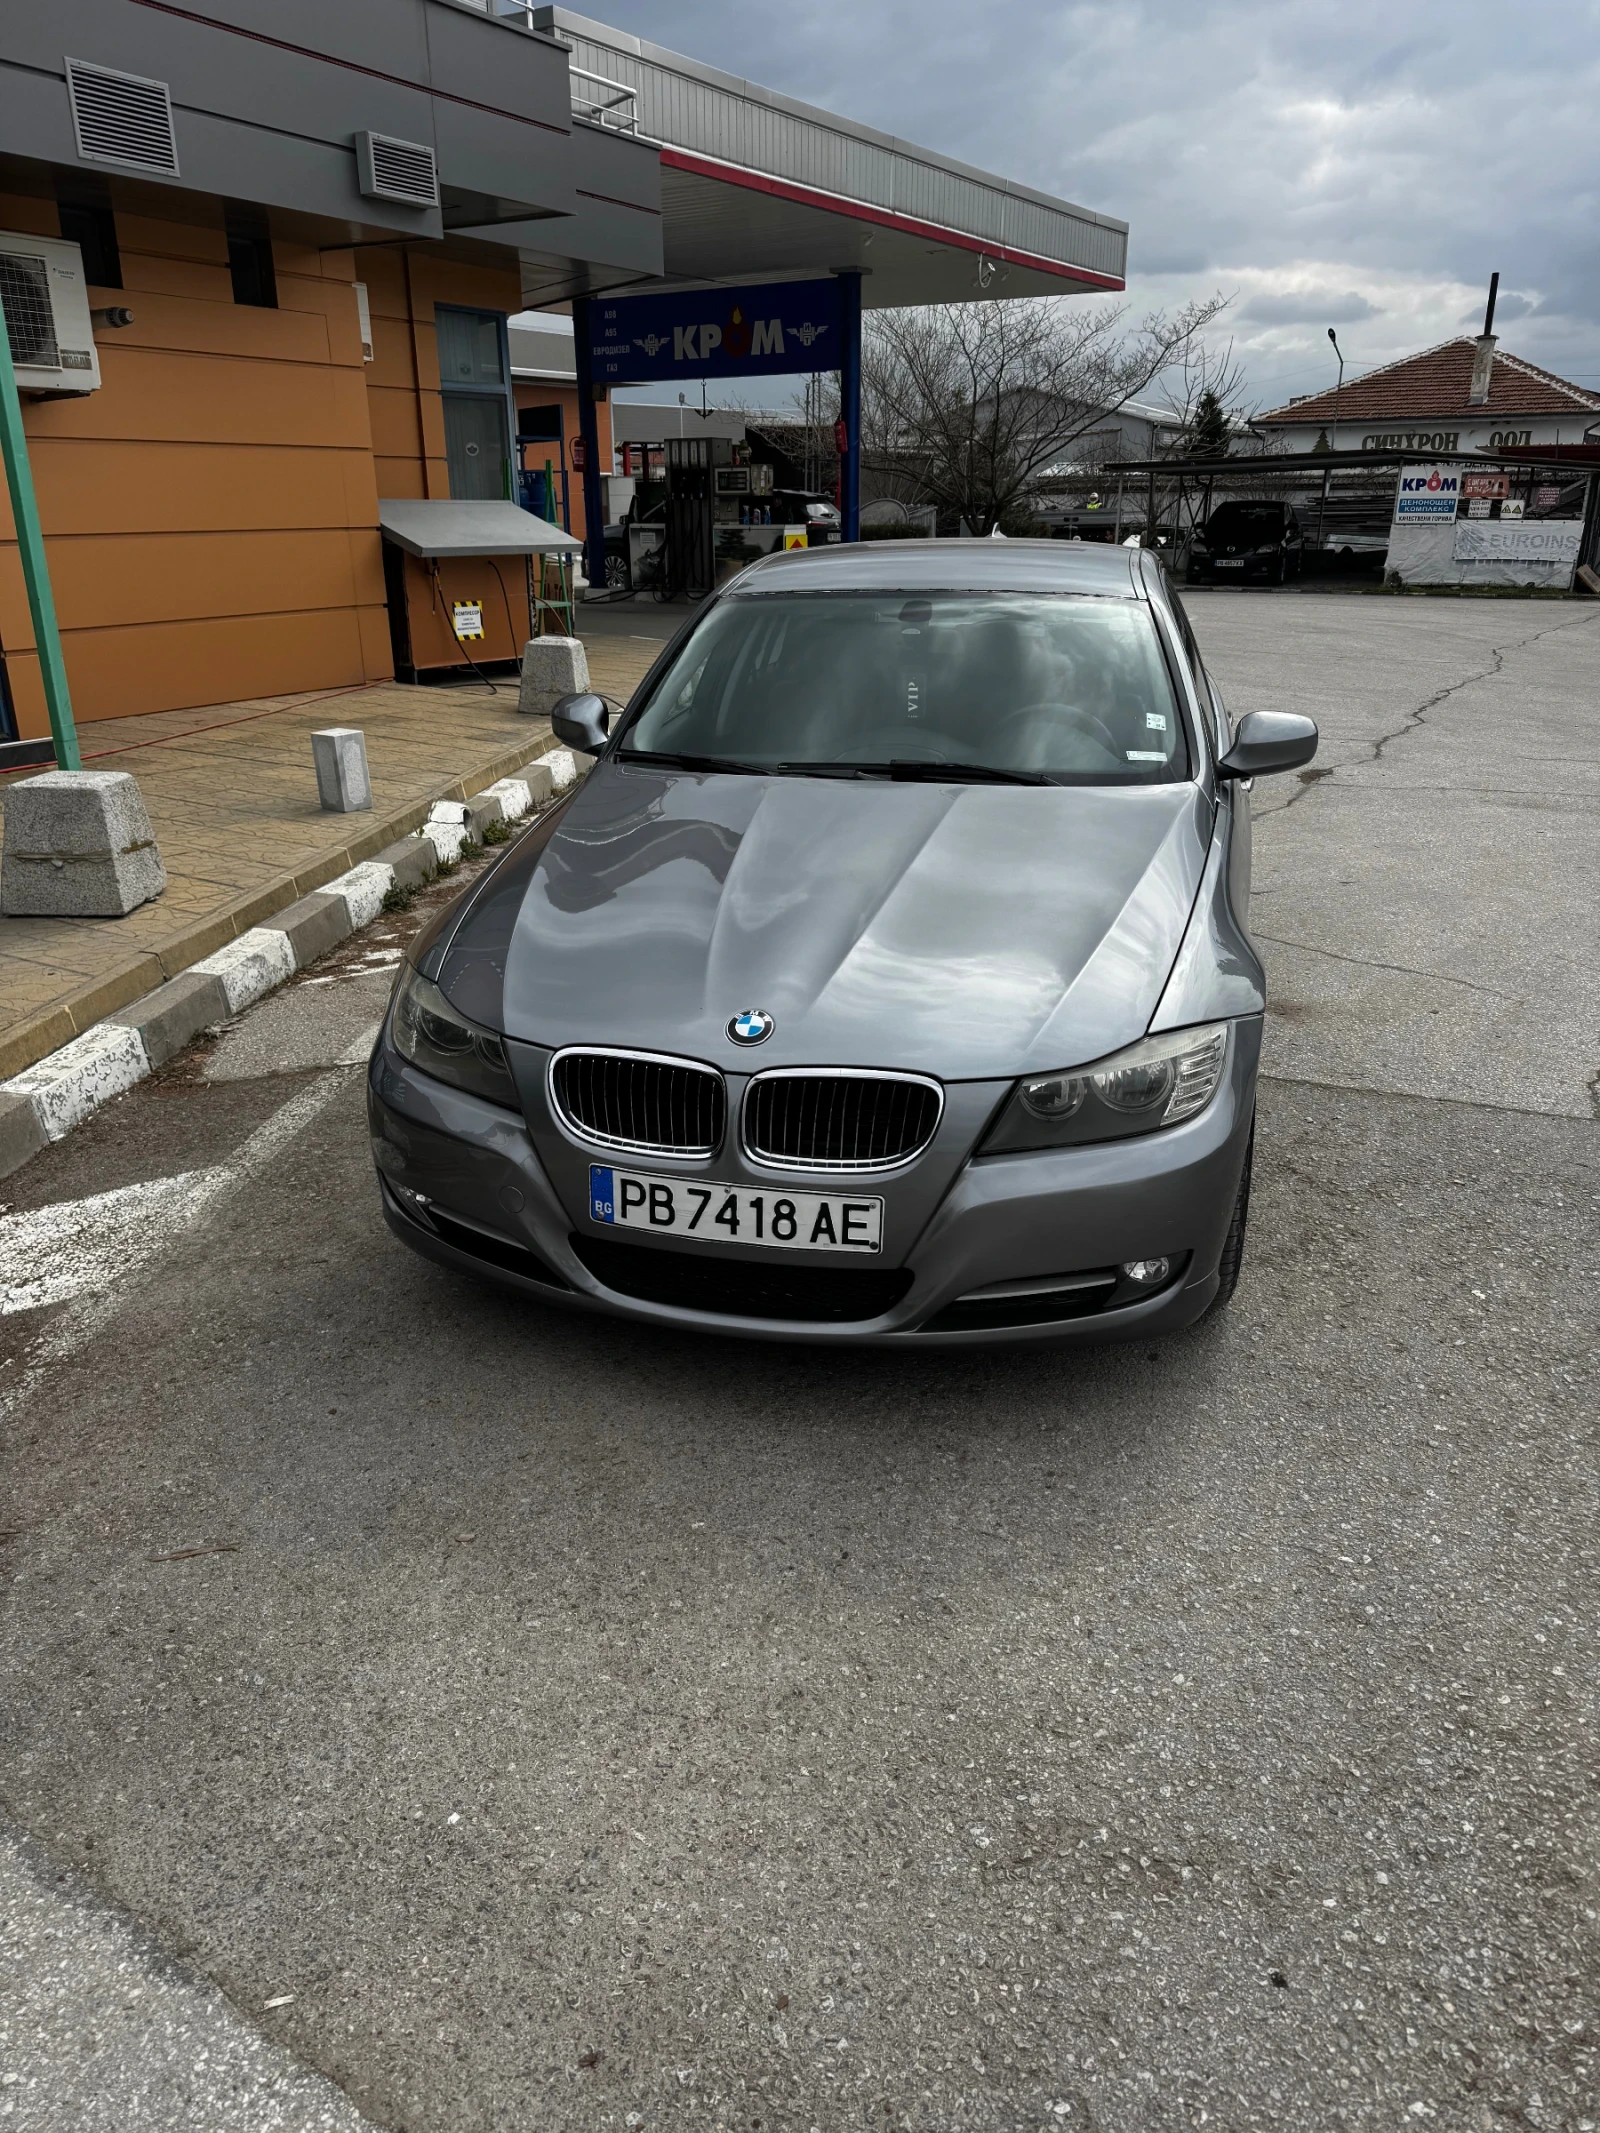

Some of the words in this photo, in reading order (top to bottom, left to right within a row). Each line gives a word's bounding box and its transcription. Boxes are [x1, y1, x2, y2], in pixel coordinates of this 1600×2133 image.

[673, 317, 785, 361] КРОМ
[607, 363, 618, 372] ГАЗ
[1362, 432, 1460, 451] СИНХРОН
[1402, 476, 1457, 492] КРОМ
[1490, 533, 1579, 550] EUROINS
[595, 1200, 612, 1214] BG
[620, 1177, 676, 1226] PB
[687, 1188, 797, 1241] 7418
[809, 1202, 870, 1246] AE
